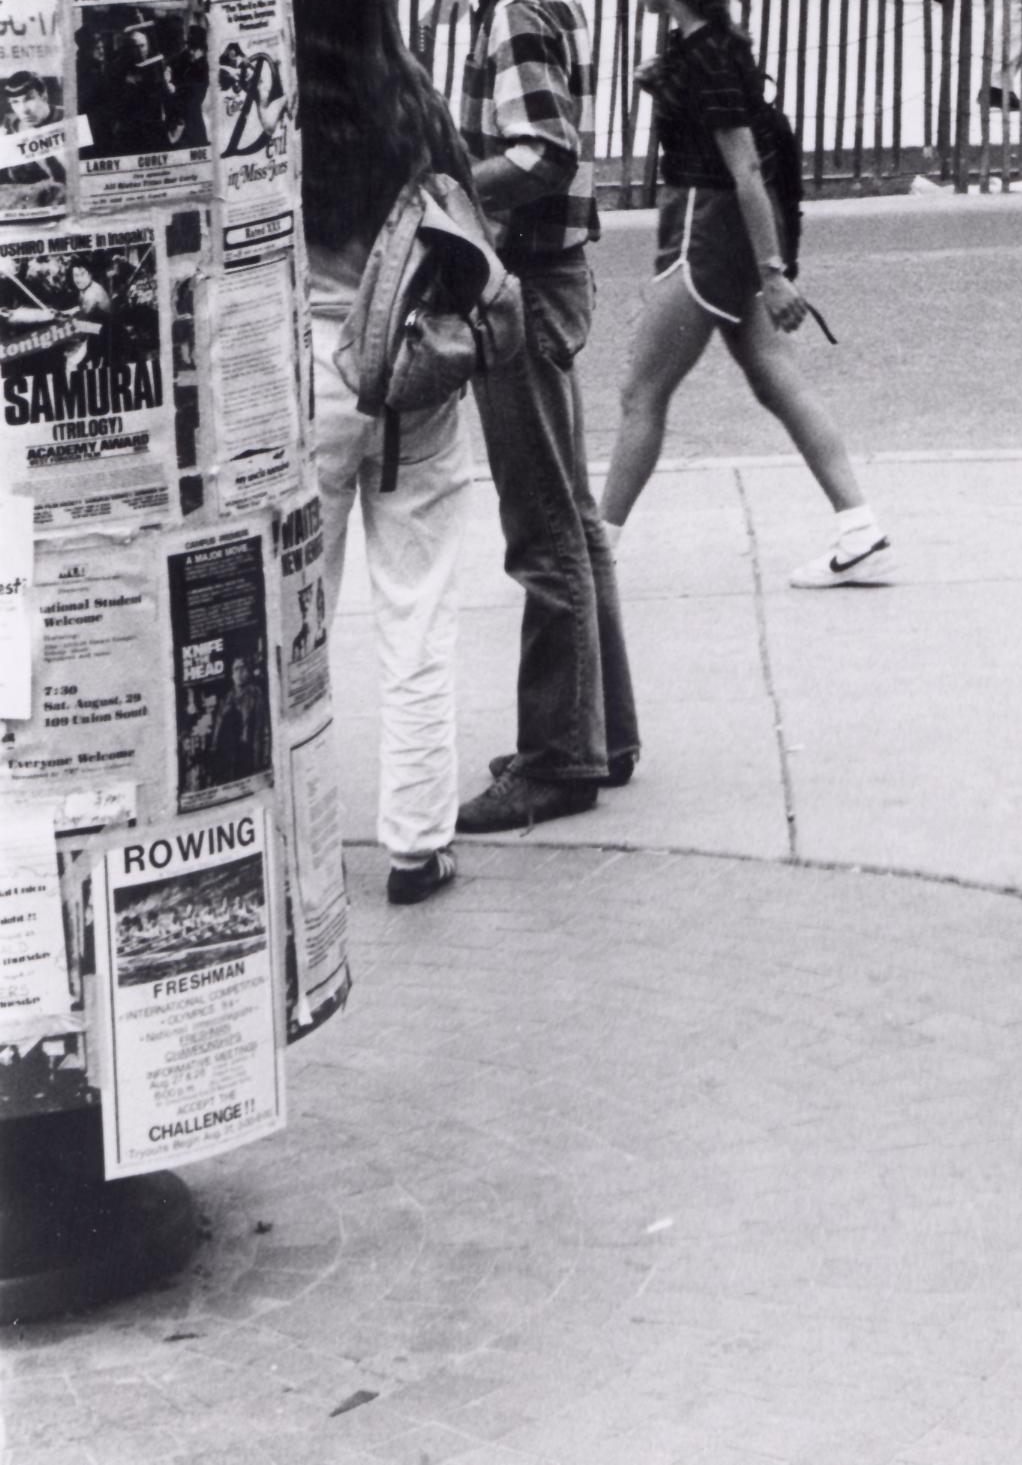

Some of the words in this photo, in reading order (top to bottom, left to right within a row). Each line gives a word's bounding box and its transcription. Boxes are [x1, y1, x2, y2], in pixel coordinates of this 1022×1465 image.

[86, 159, 121, 173] LARRY
[137, 153, 169, 168] CURLY
[245, 224, 264, 239] Rated
[3, 359, 164, 426] SAMURAI
[52, 415, 124, 442] (TRILOGY)
[26, 441, 97, 462] ACADEMY
[99, 433, 150, 452] AWARD
[44, 614, 103, 628] Welcome
[182, 637, 223, 661] KNIFE
[183, 659, 225, 682] HEAD
[44, 701, 70, 711] Sat.
[72, 713, 112, 725] Union
[8, 757, 73, 771] Everyone
[77, 749, 135, 764] Welcome
[124, 817, 256, 874] ROWING
[153, 960, 246, 999] FRESHMAN
